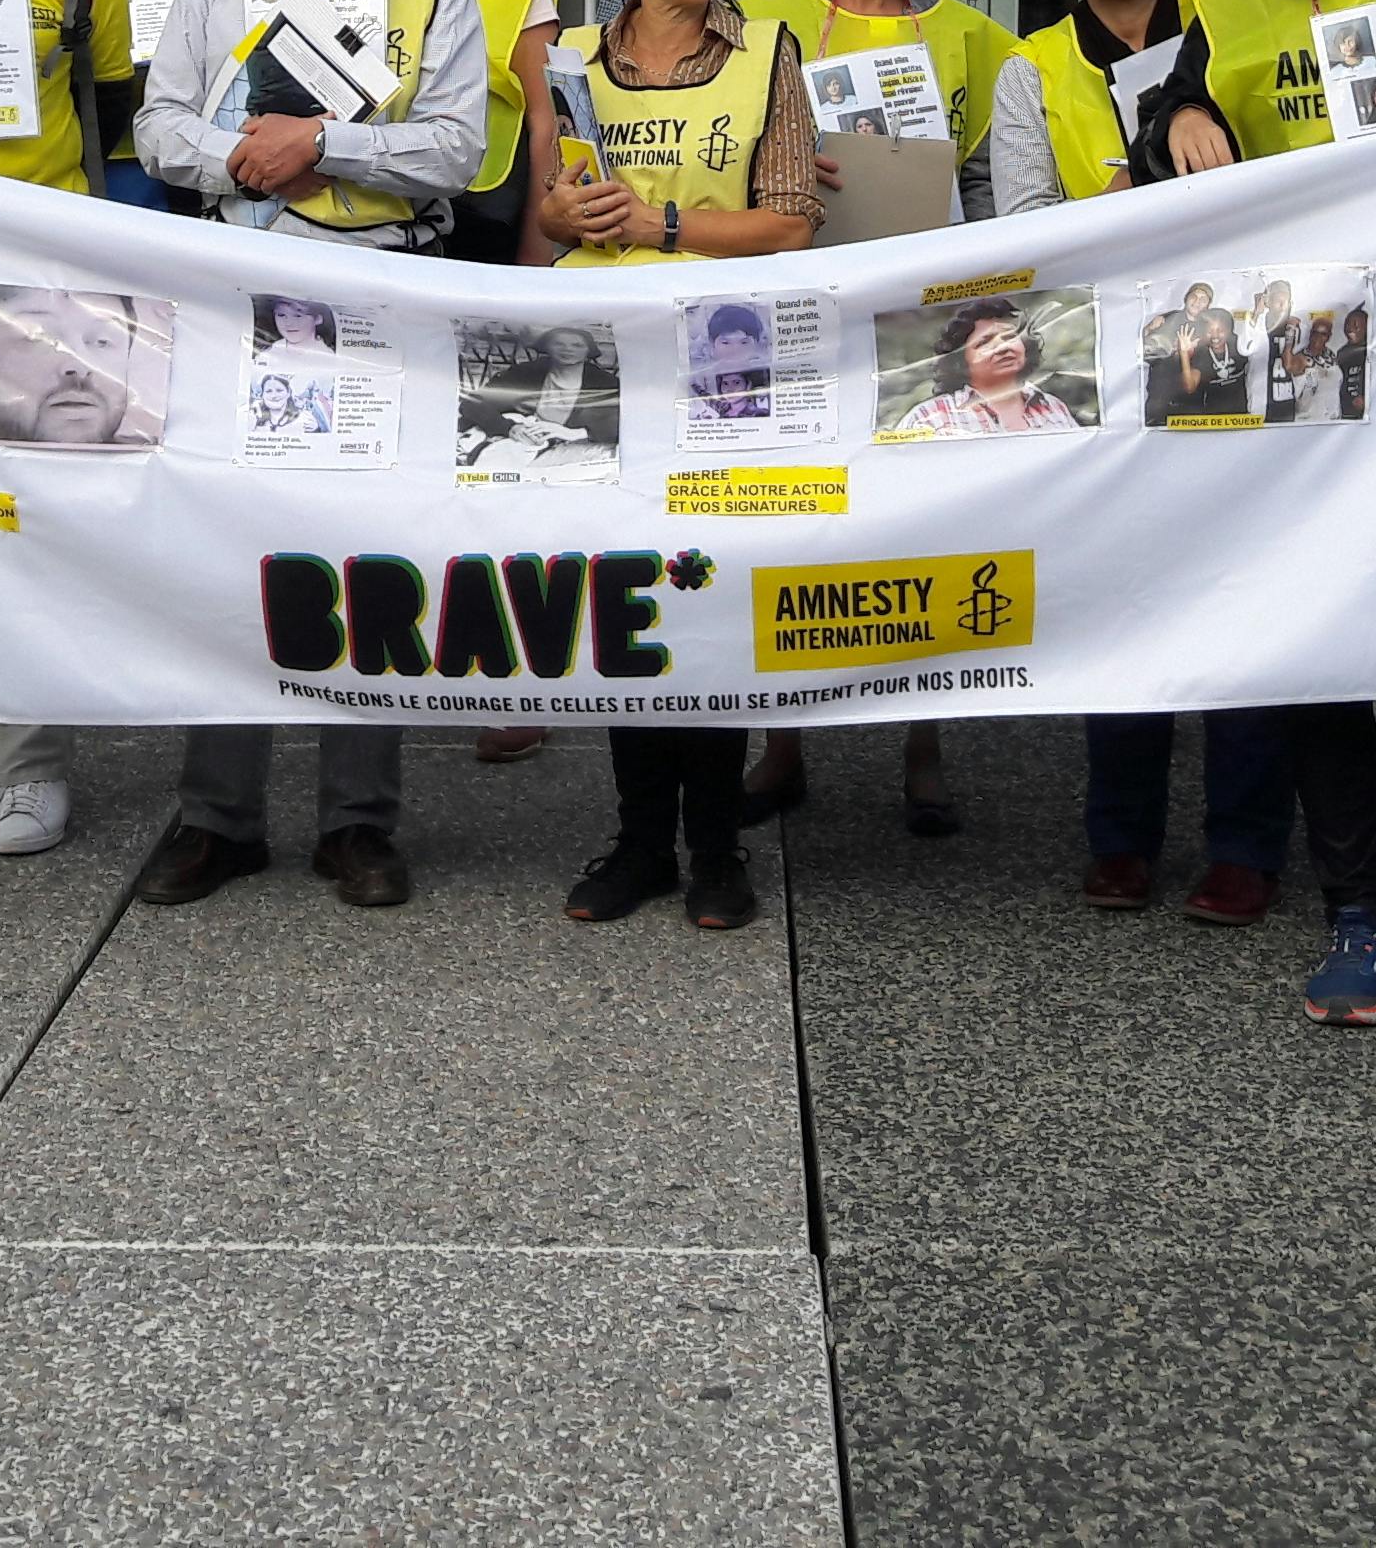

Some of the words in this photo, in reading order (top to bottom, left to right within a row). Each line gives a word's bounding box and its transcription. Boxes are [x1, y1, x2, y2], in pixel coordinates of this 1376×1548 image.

[598, 119, 688, 147] MNESTY
[606, 150, 685, 168] RNATIONAL
[775, 298, 801, 310] Quand
[776, 312, 795, 322] était
[796, 310, 822, 322] petite,
[778, 326, 792, 336] Tep
[794, 324, 818, 334] rêvait
[1170, 418, 1209, 427] AFRIQUE
[1210, 418, 1223, 427] DE
[1224, 417, 1262, 427] L'OUEST
[494, 473, 521, 482] CHINE
[668, 484, 720, 497] GRÂCE
[738, 484, 788, 496] NOTRE
[792, 483, 846, 495] ACTION
[668, 501, 687, 513] ET
[690, 501, 720, 513] VOS
[727, 500, 818, 513] SIGNATURES
[775, 577, 934, 622] AMNESTY
[776, 620, 936, 652] INTERNATIONAL
[278, 680, 395, 710] PROTÉGEONS
[398, 694, 421, 711] LE
[426, 694, 515, 713] COURAGE
[520, 696, 545, 713] DE
[550, 698, 619, 714] CELLES
[625, 696, 645, 714] ET
[652, 695, 702, 712] CEUX
[708, 694, 741, 712] QUI
[746, 692, 770, 710] SE
[776, 683, 854, 707] BATTENT
[859, 676, 911, 698] POUR
[916, 670, 954, 692] NOS
[960, 666, 1035, 689] DROITS.
